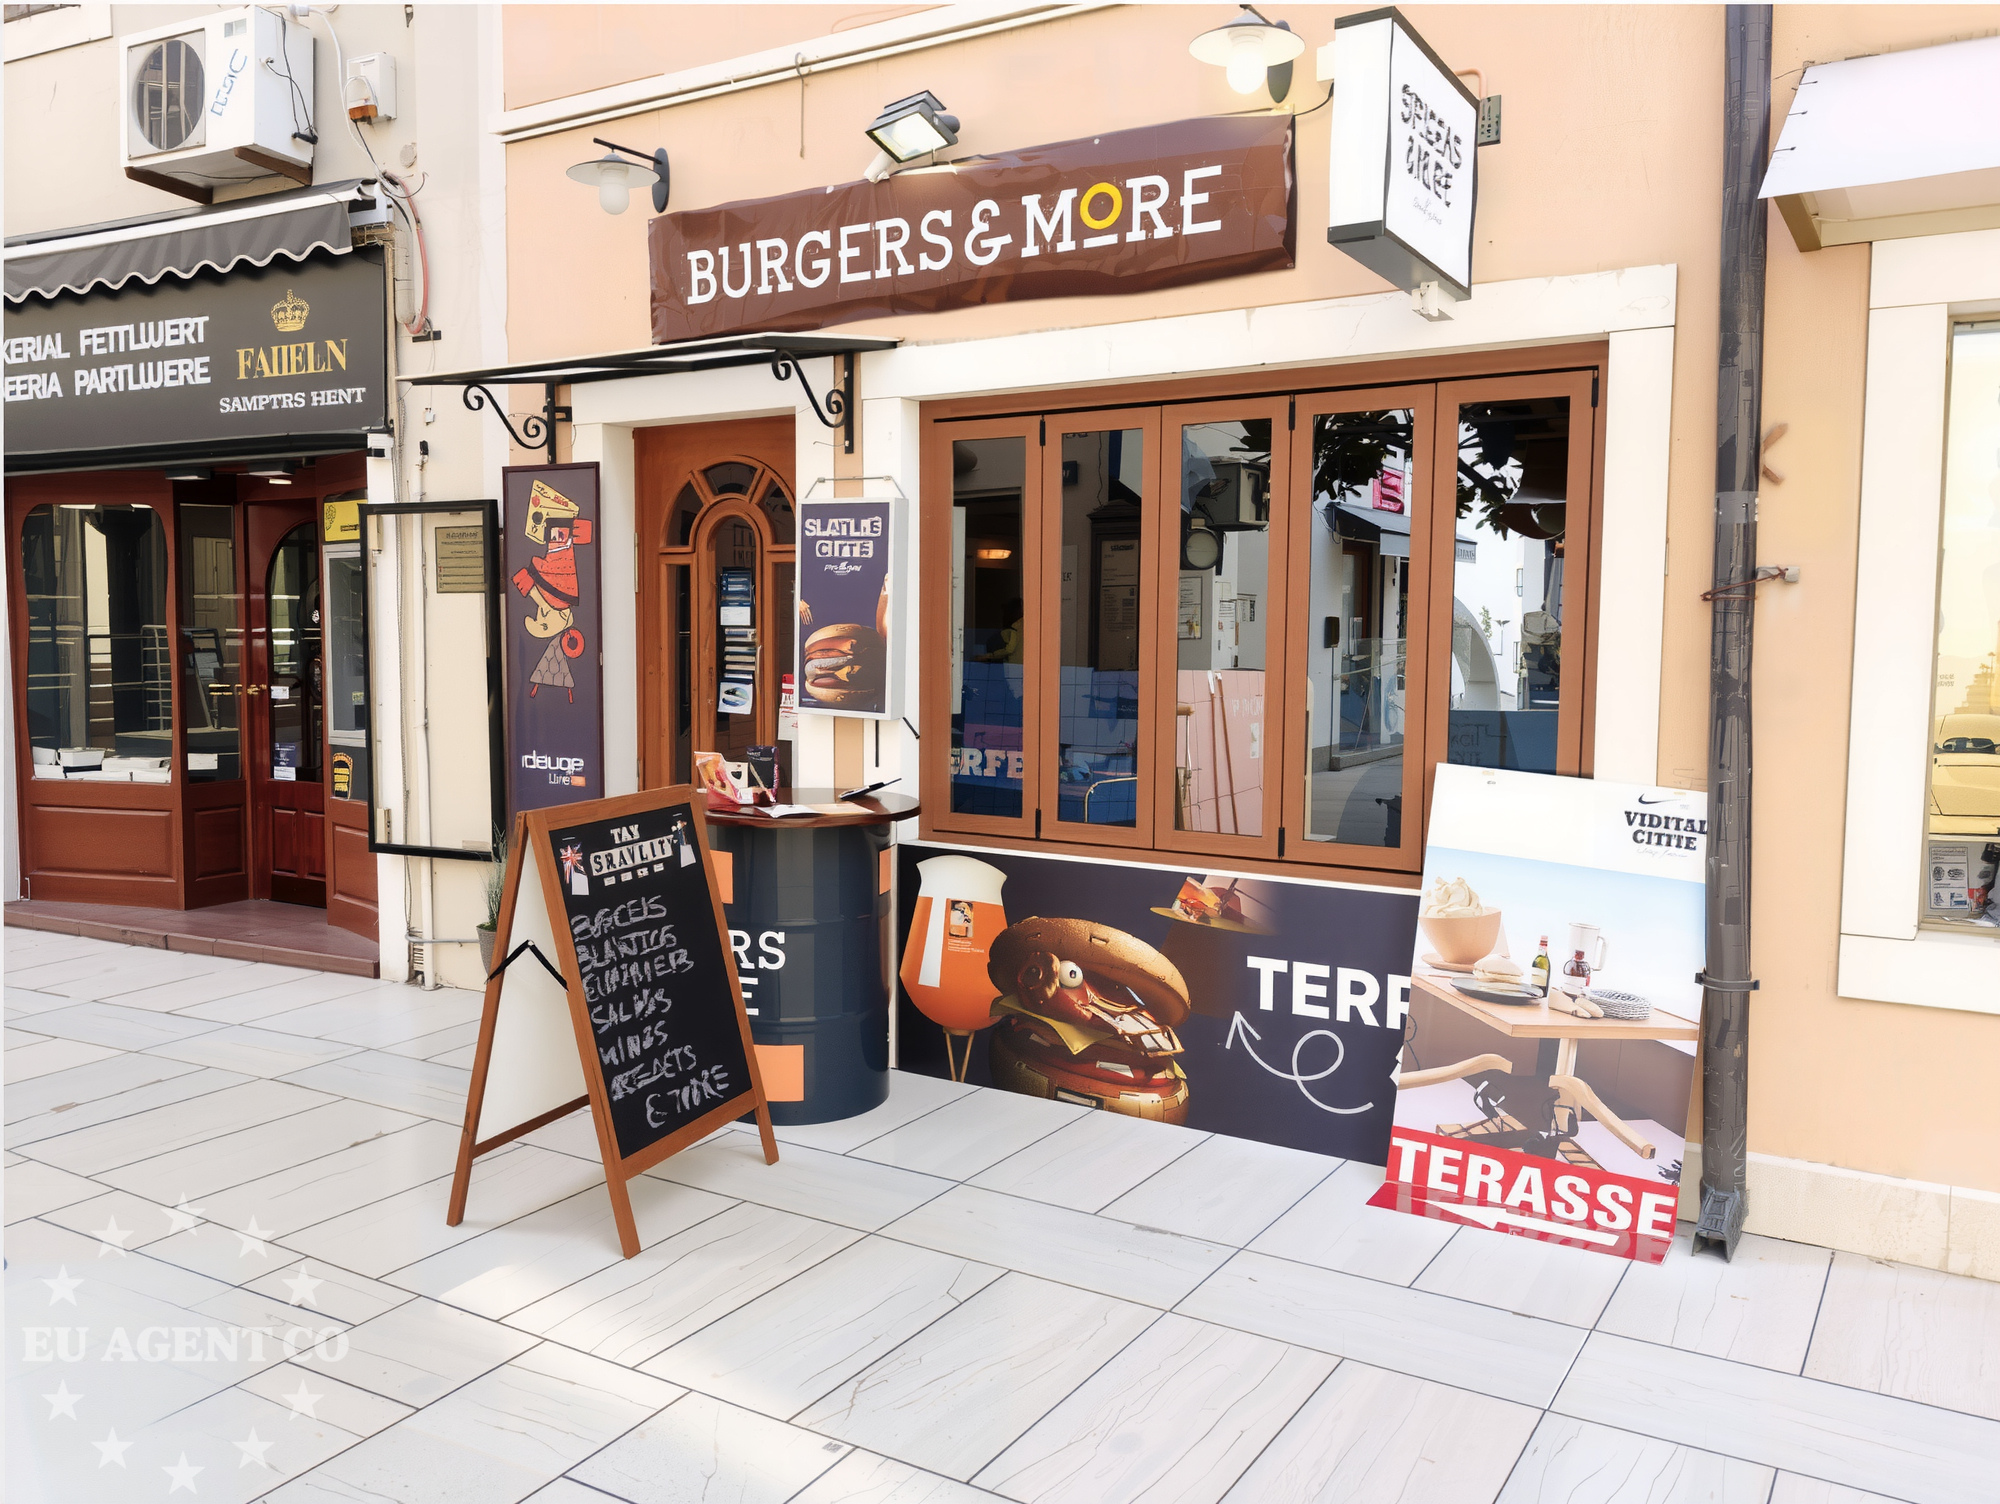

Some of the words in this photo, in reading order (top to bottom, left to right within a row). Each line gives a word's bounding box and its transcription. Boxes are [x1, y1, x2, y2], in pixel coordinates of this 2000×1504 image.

[687, 209, 953, 305] BURGERS
[964, 199, 1012, 266] &
[1020, 165, 1223, 257] MORE
[311, 387, 366, 407] HENT
[1391, 1136, 1676, 1238] TERASSE
